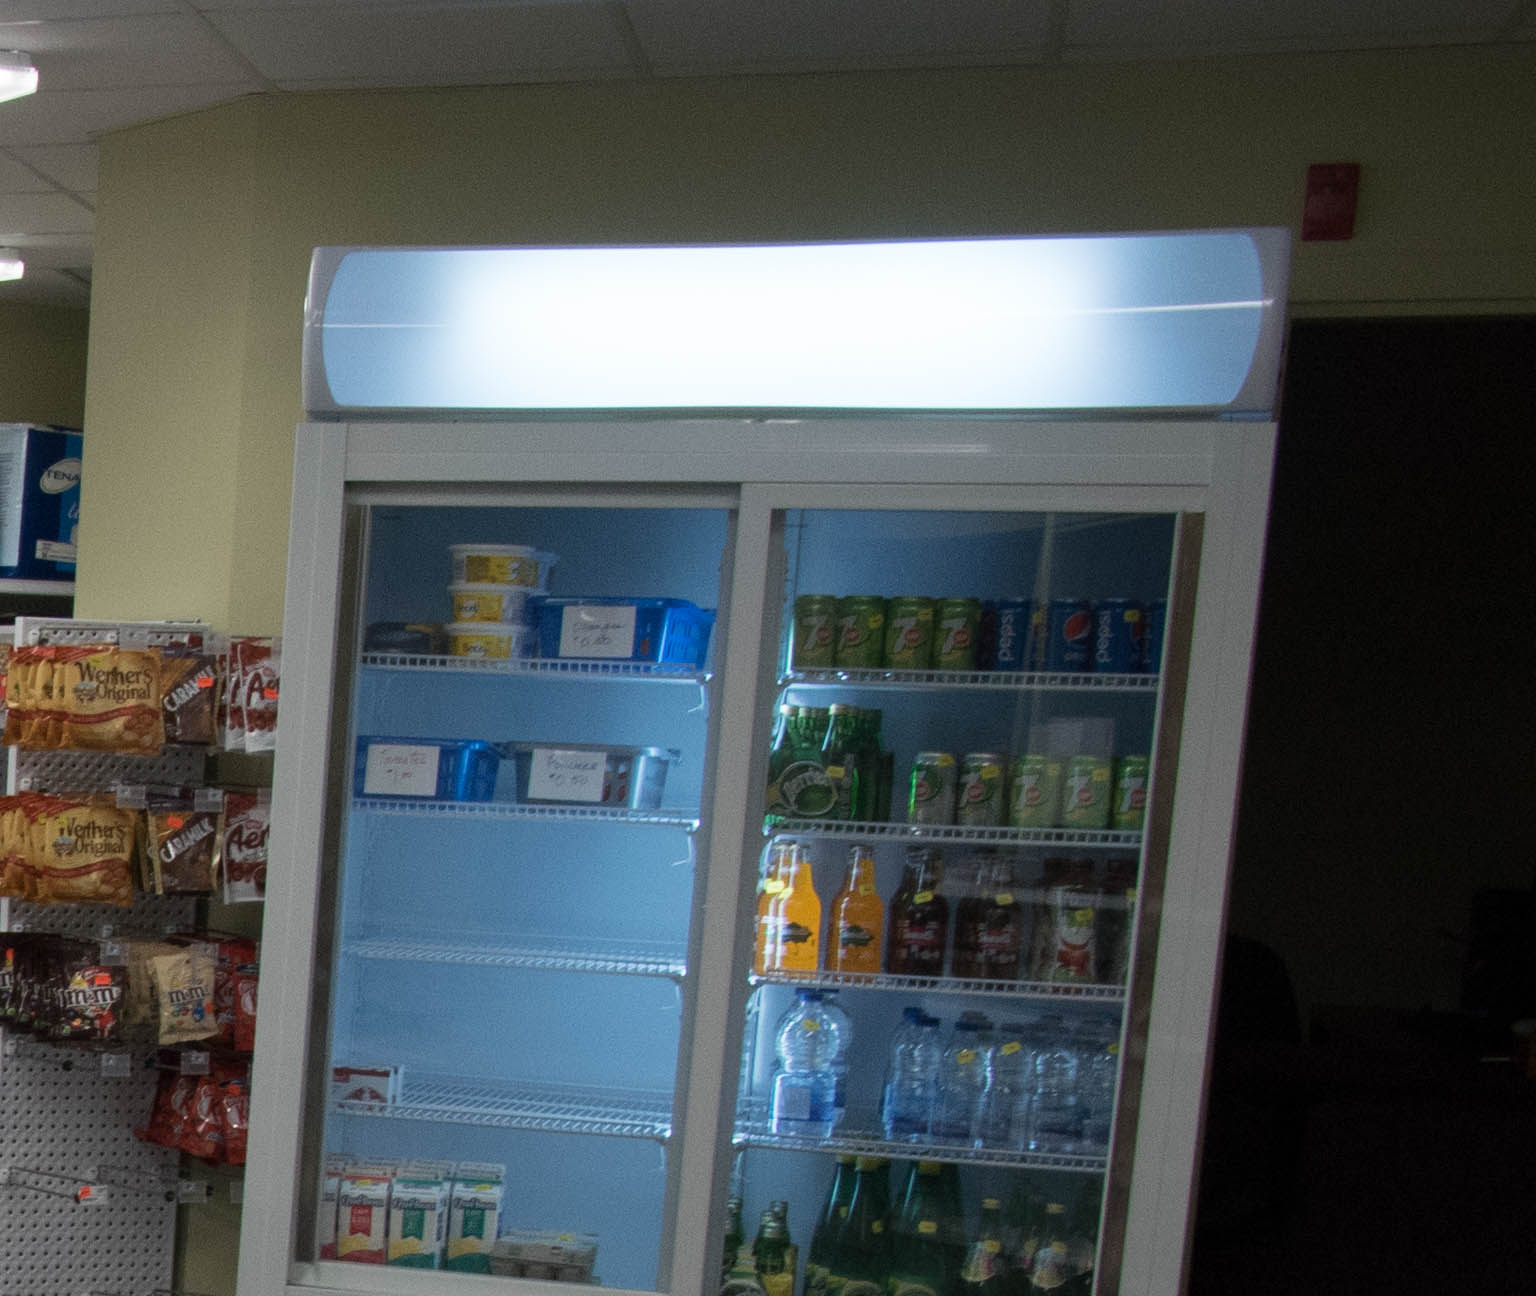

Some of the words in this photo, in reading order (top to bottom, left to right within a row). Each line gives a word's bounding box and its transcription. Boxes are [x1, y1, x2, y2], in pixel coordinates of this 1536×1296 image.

[46, 470, 80, 482] TENA
[998, 608, 1015, 663] pepsi
[1096, 610, 1112, 663] pepsi
[77, 662, 153, 687] Werther's
[96, 686, 151, 702] Original
[59, 817, 125, 840] Werther's
